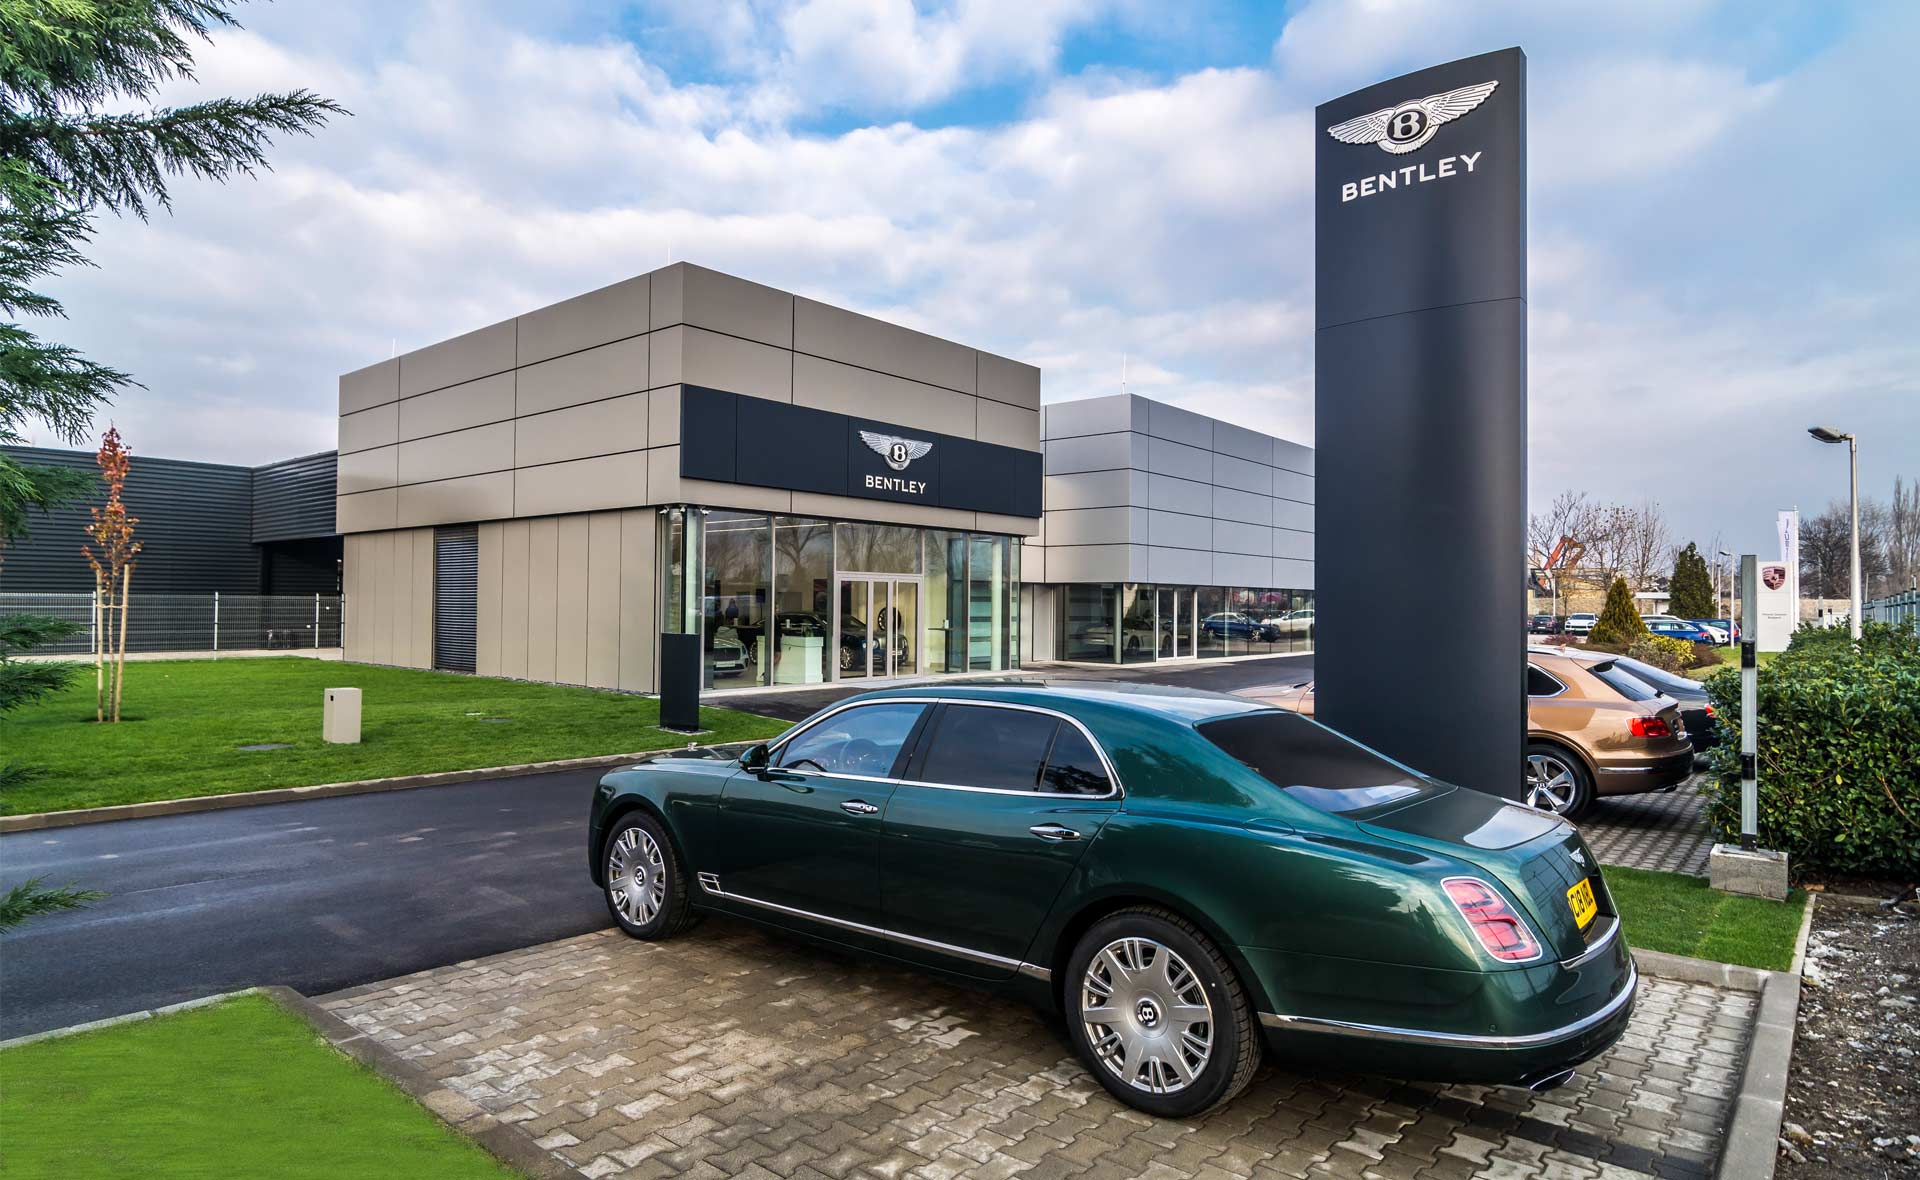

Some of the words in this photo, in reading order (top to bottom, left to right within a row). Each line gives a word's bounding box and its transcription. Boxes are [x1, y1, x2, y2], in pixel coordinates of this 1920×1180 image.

[1393, 111, 1420, 138] B
[1342, 151, 1482, 202] BENTLEY
[893, 444, 906, 462] B
[865, 475, 926, 494] BENTLEY
